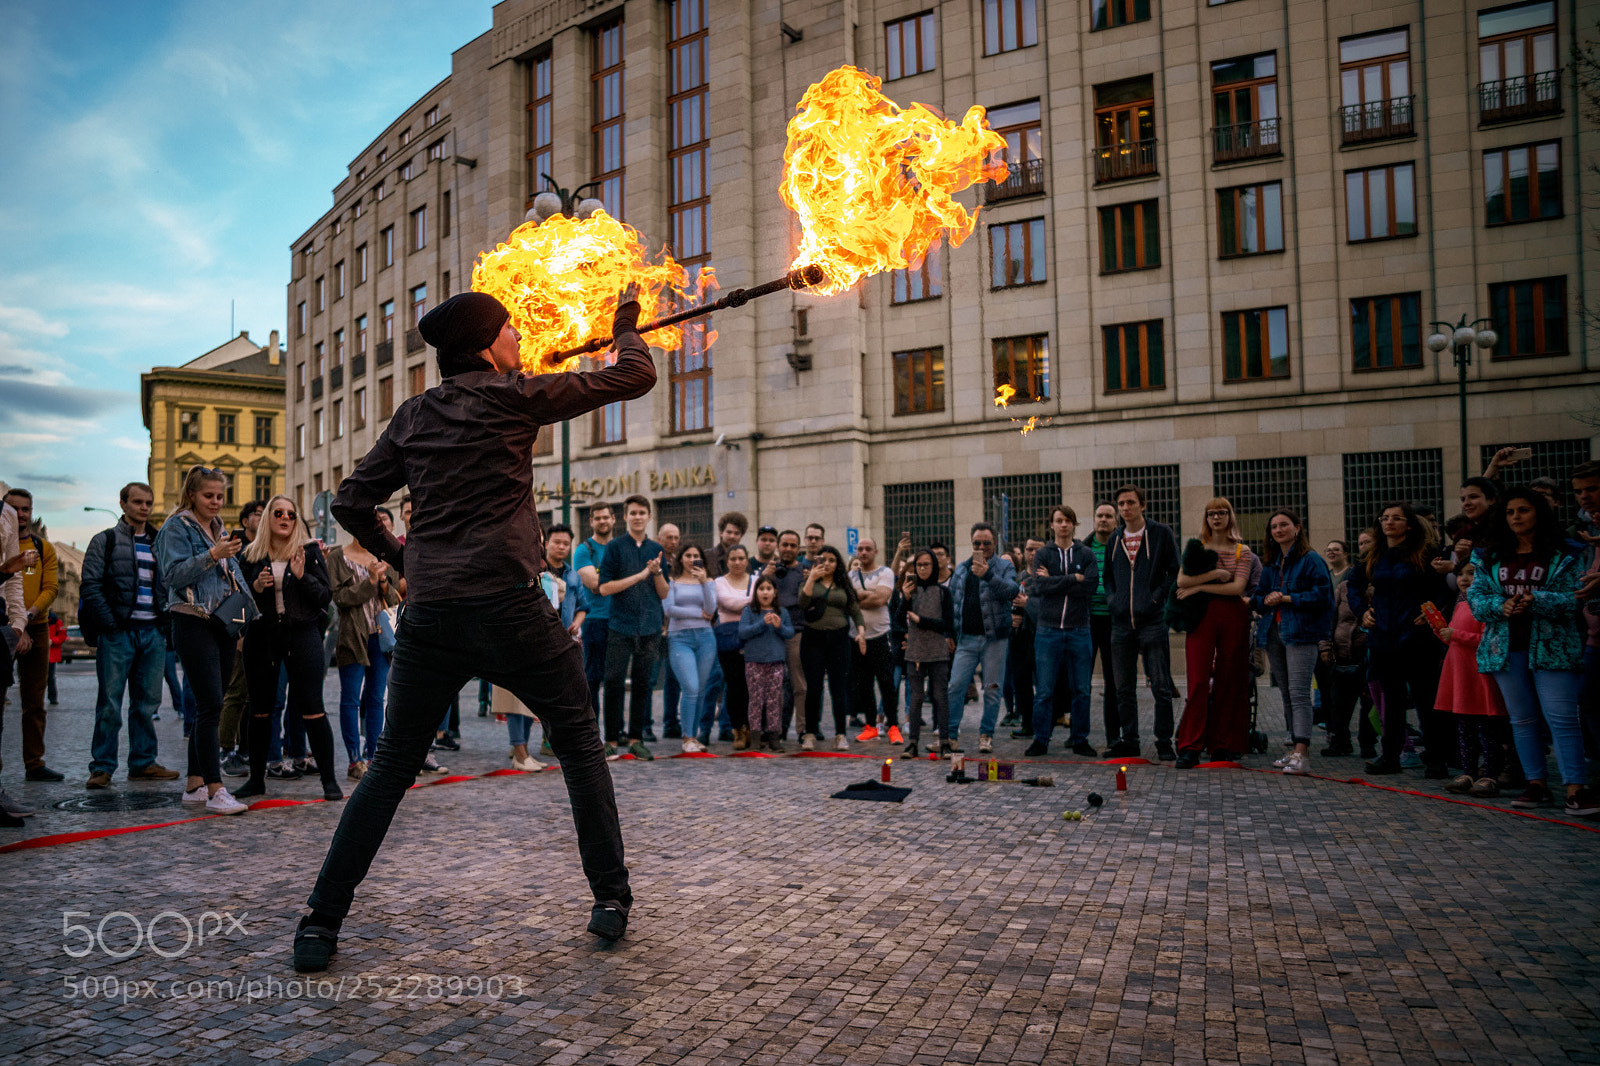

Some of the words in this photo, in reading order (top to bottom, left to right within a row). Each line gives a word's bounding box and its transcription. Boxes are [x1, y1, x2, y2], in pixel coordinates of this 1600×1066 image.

[649, 464, 717, 492] BANKA
[849, 531, 857, 546] P
[1499, 566, 1545, 581] BAD
